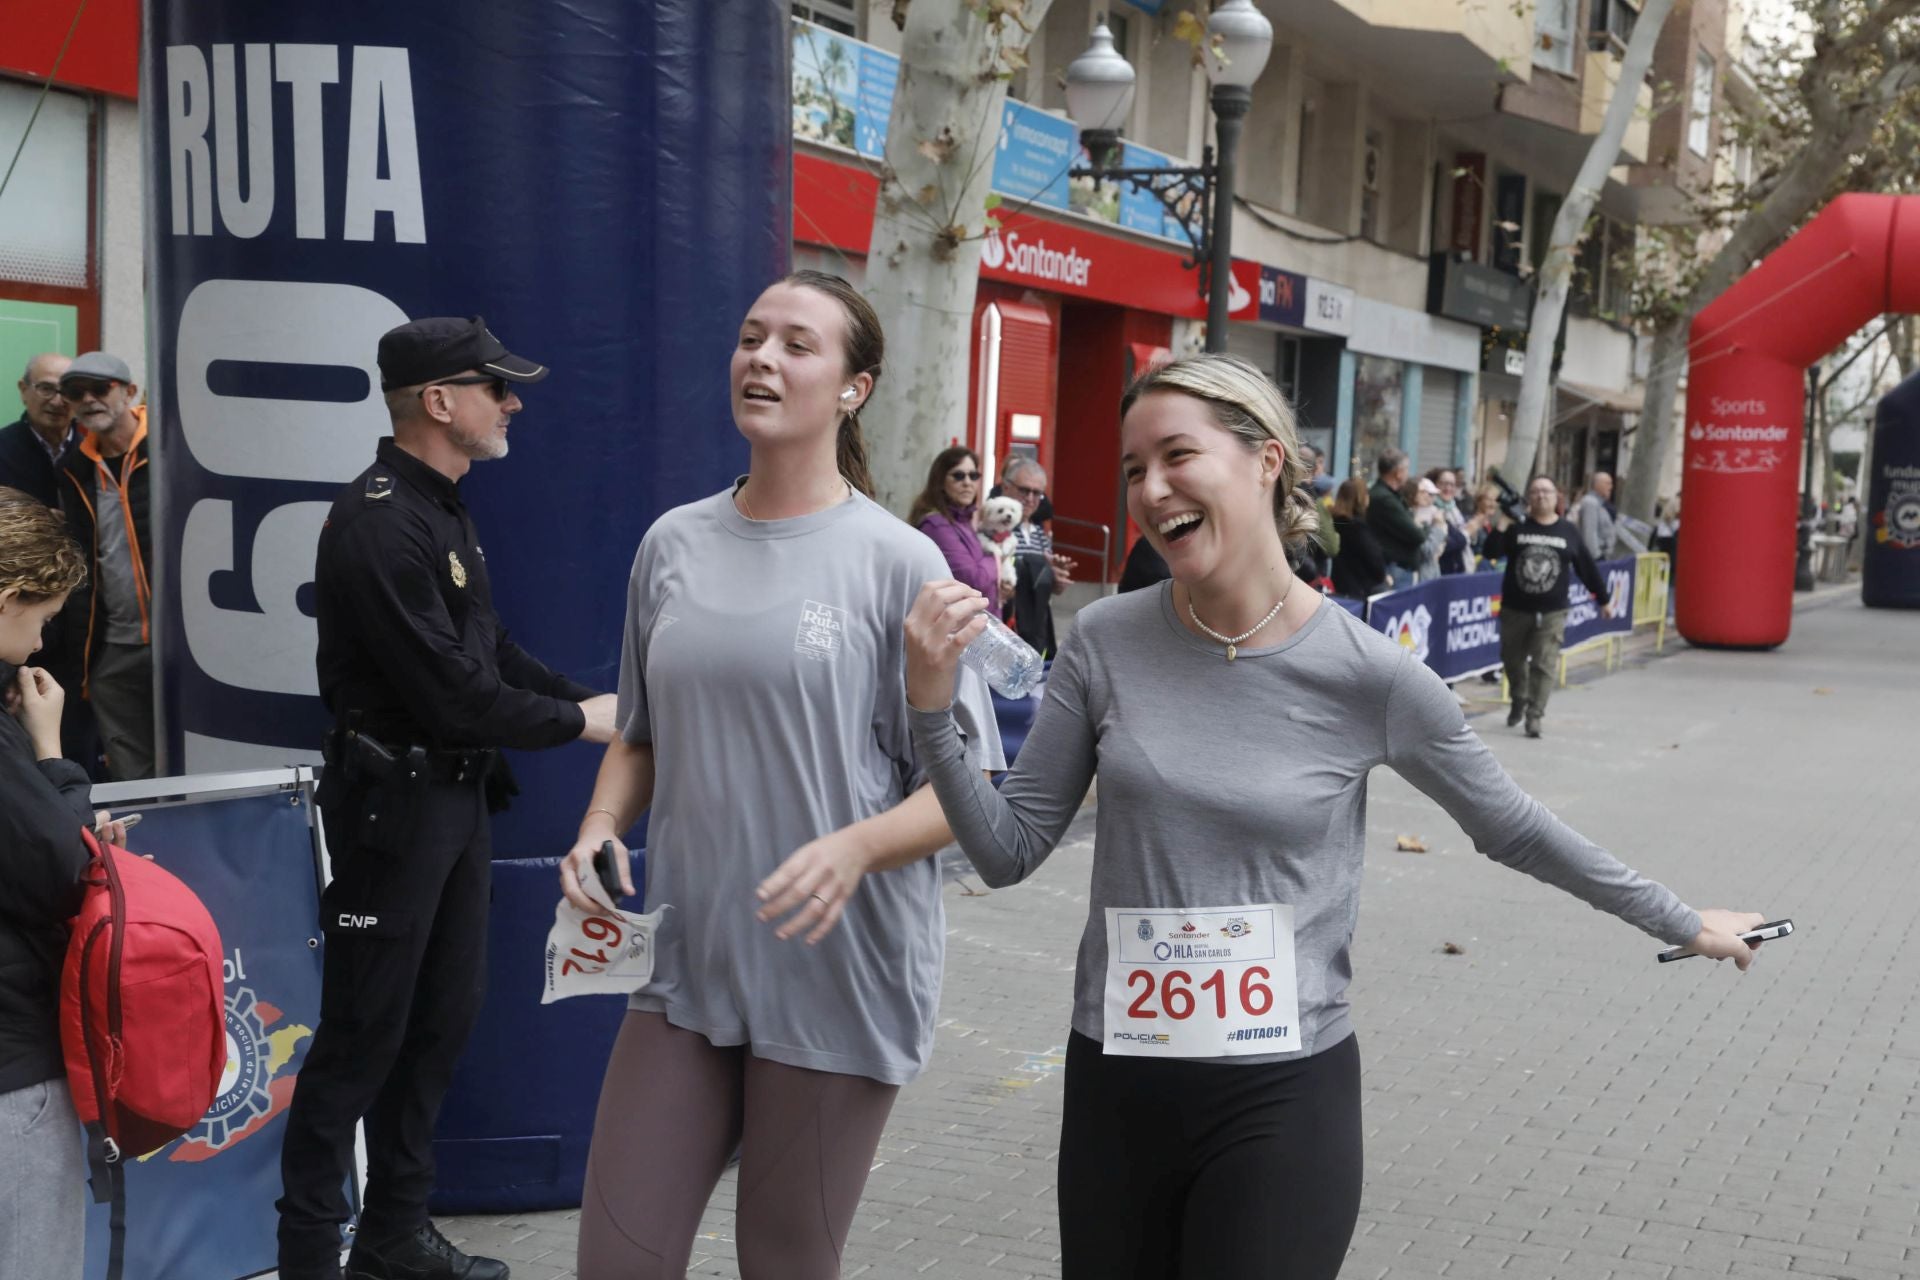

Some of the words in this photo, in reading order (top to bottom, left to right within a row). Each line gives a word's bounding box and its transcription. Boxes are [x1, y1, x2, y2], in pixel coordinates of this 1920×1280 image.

[166, 43, 427, 244] RUTA
[1005, 230, 1092, 287] Santander
[1711, 396, 1767, 418] Sports
[1705, 423, 1790, 442] Santander
[803, 610, 841, 631] Ruta
[806, 630, 832, 648] Sal
[1446, 620, 1500, 653] NACIONAL
[338, 913, 378, 929] CNP
[1174, 945, 1193, 959] HLA
[1194, 950, 1207, 958] SAN
[1208, 948, 1232, 958] CARLOS
[1127, 966, 1274, 1020] 2616
[234, 1023, 254, 1056] social
[1227, 1026, 1288, 1042] #RUTA091
[245, 1061, 255, 1074] de
[242, 1078, 252, 1089] la
